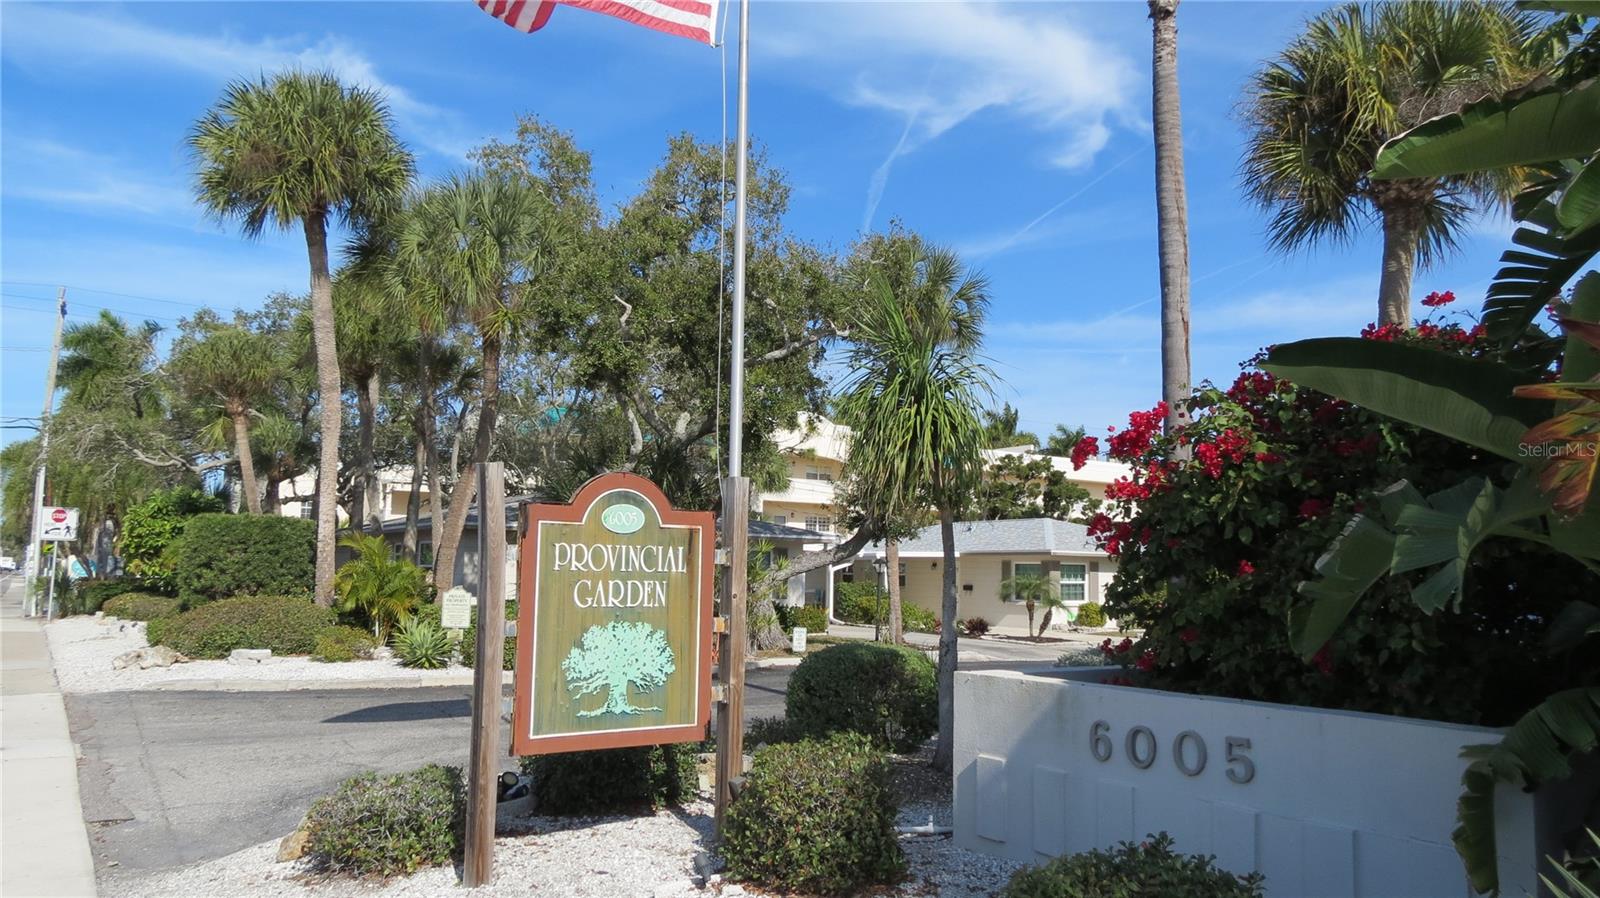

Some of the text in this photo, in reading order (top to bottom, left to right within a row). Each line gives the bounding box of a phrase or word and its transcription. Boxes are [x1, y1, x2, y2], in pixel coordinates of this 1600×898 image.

[608, 511, 638, 526] 6005
[553, 542, 687, 573] PROVINCIAL
[573, 579, 668, 608] GARDEN
[1089, 719, 1255, 784] 6005
